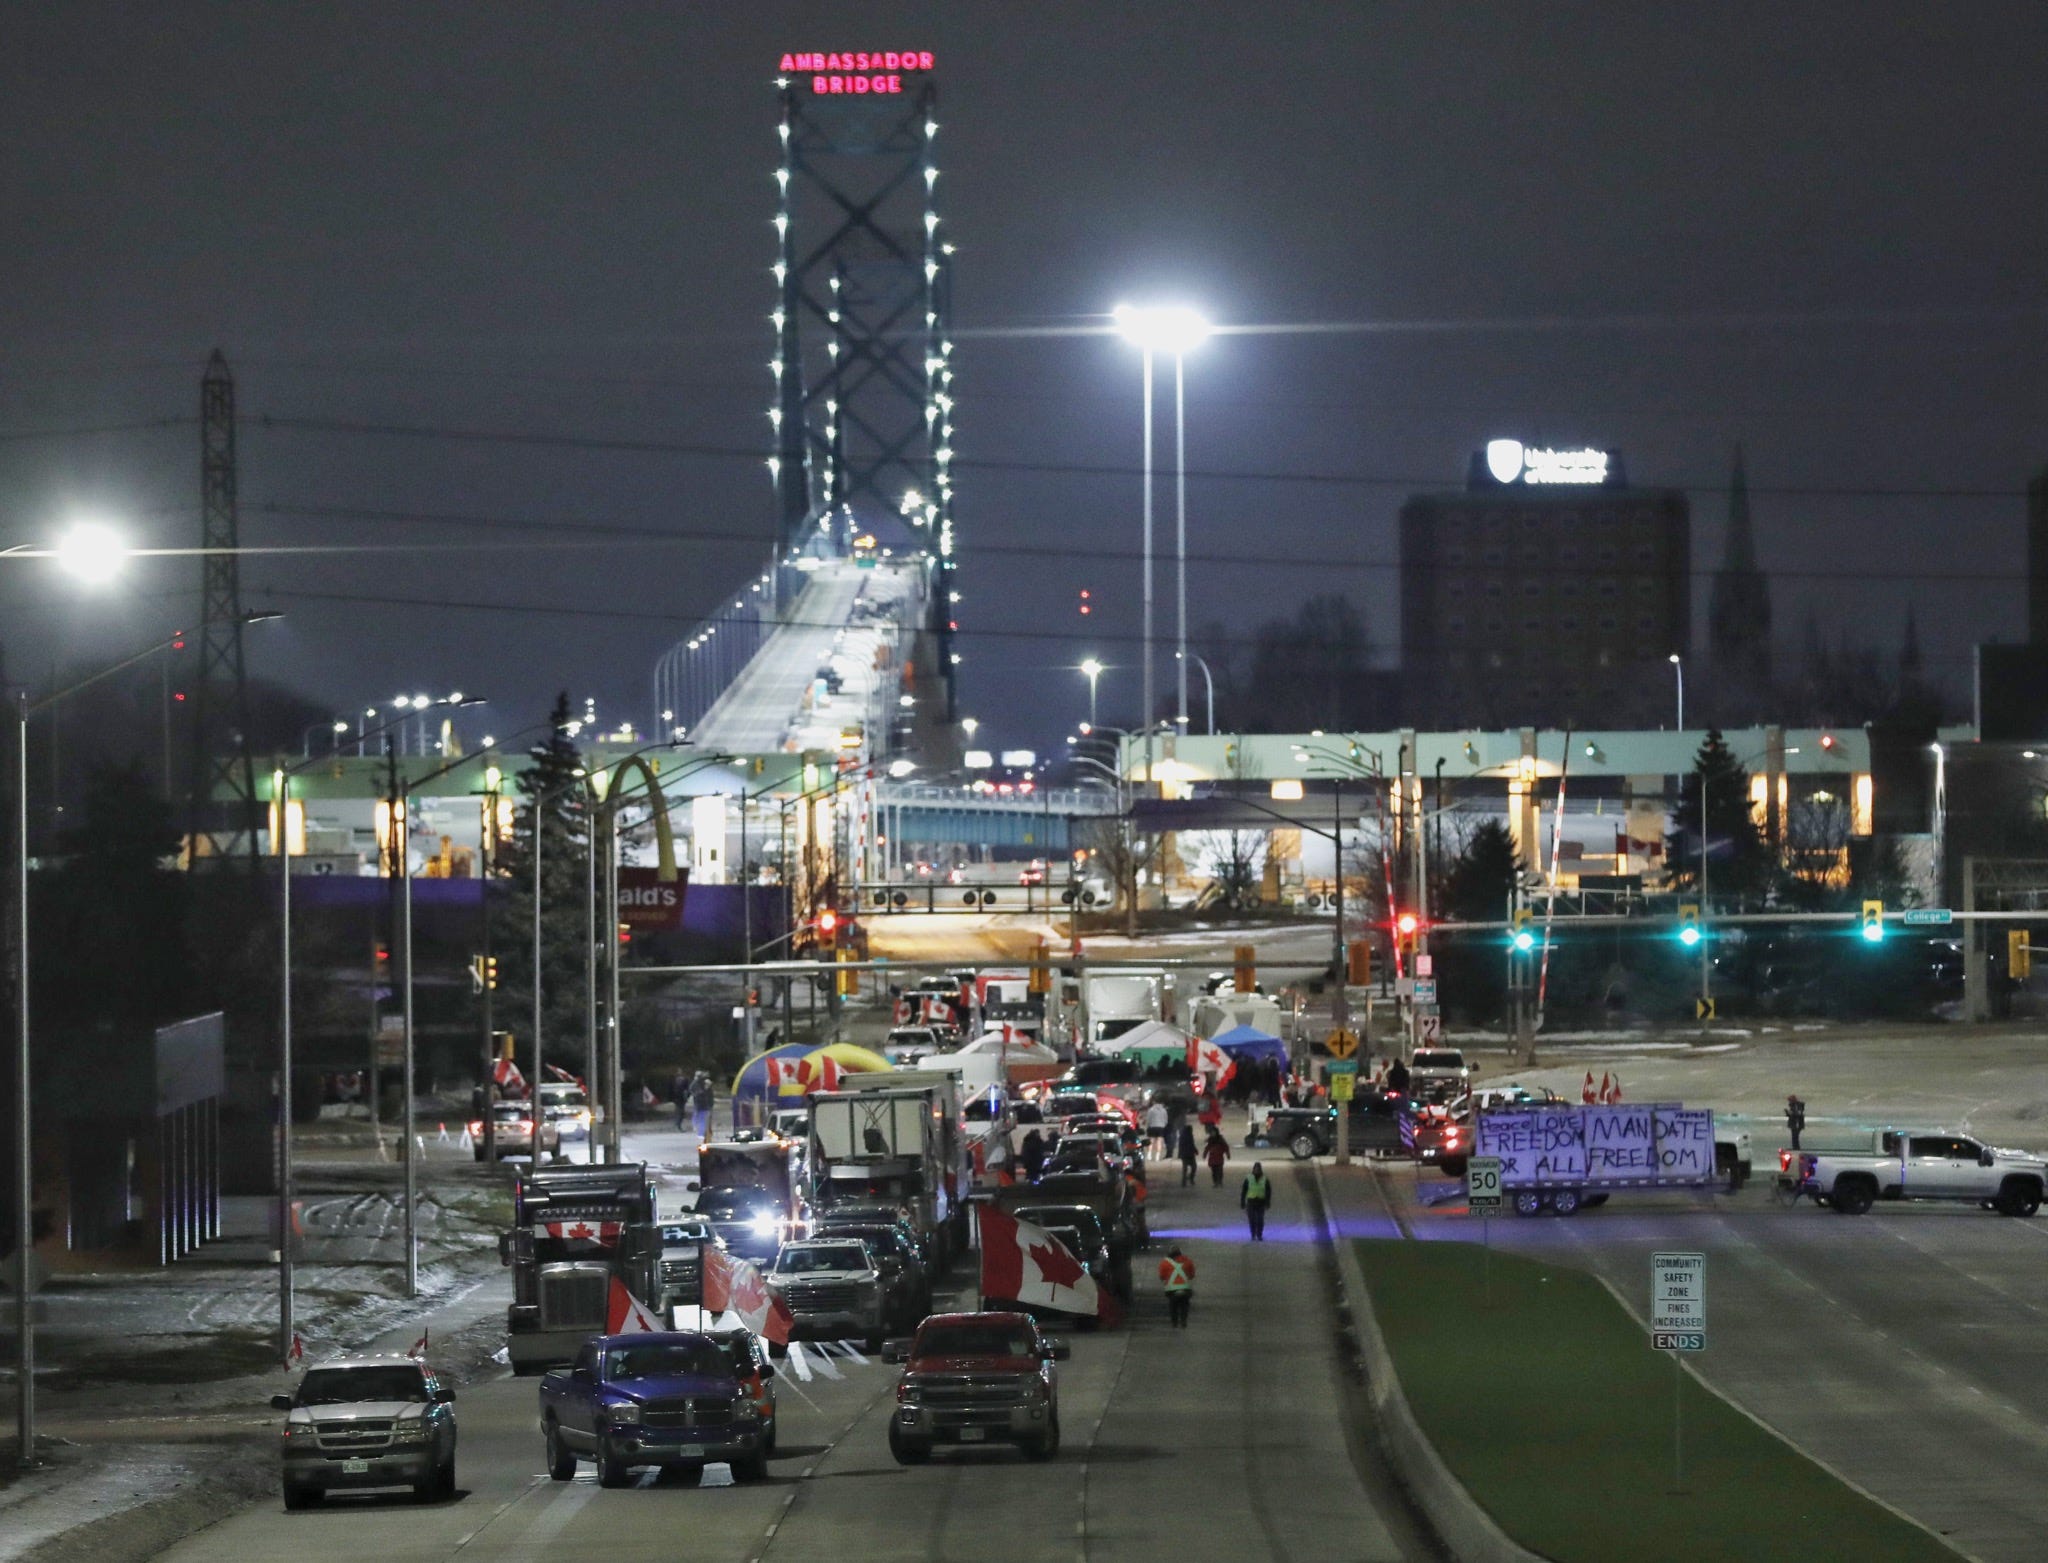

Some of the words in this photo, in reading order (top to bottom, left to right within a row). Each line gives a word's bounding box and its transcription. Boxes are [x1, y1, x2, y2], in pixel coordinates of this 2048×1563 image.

[779, 52, 935, 71] AMBASSADOR
[813, 75, 902, 94] BRIDGE
[1907, 911, 1941, 923] College
[1480, 1118, 1531, 1133] Peace
[1536, 1116, 1580, 1134] LOVE
[1593, 1116, 1708, 1142] MANDATE
[1481, 1128, 1585, 1152] FREEDOM
[1536, 1156, 1584, 1176] ALL
[1471, 1172, 1497, 1190] 50
[1655, 1259, 1702, 1268] COMMUNITY
[1664, 1273, 1694, 1282] SAFETY
[1668, 1287, 1689, 1297] ZONE
[1667, 1304, 1690, 1313] FINES
[1655, 1317, 1702, 1327] INCREASED
[1657, 1335, 1700, 1348] ENDS
